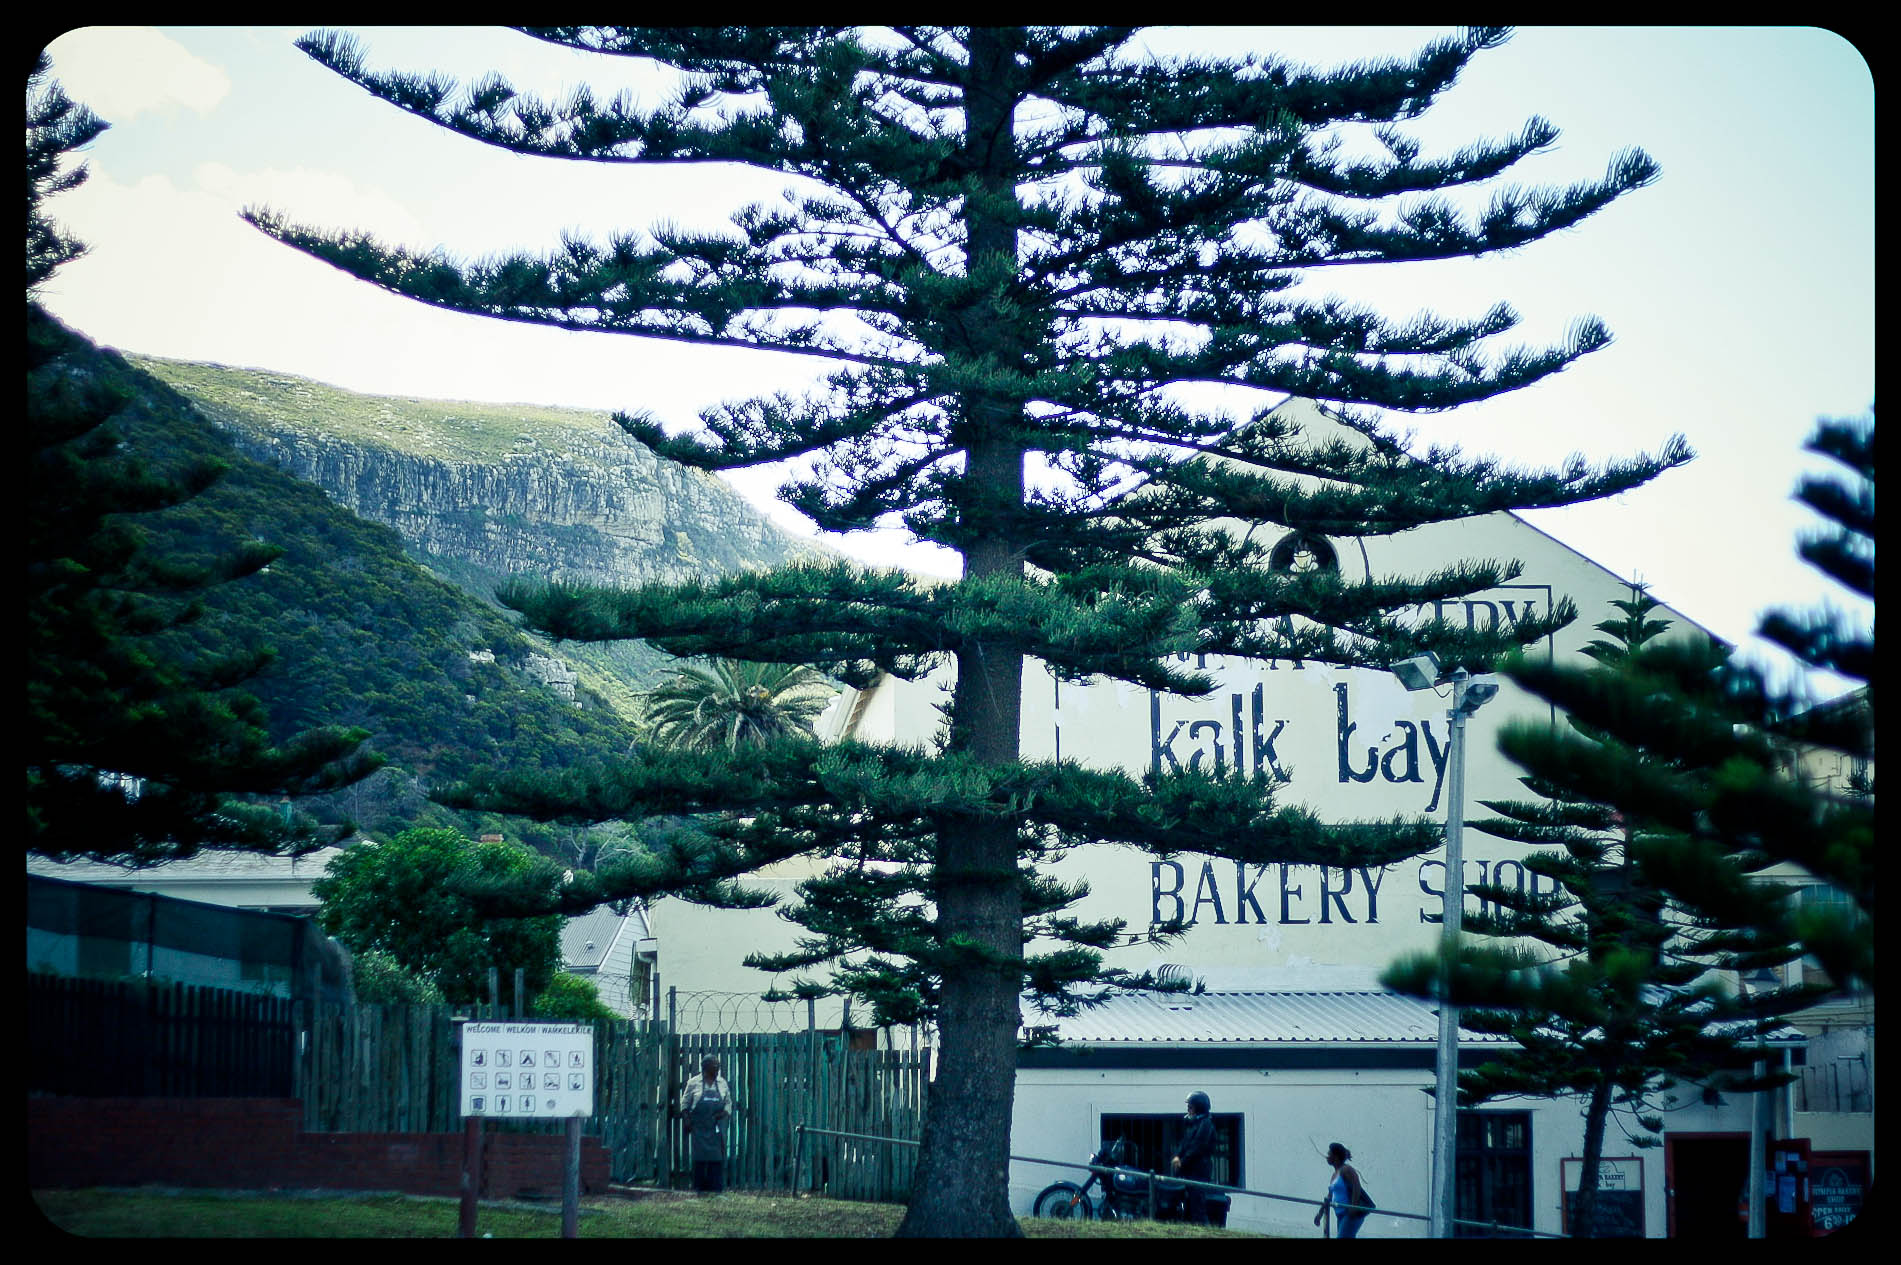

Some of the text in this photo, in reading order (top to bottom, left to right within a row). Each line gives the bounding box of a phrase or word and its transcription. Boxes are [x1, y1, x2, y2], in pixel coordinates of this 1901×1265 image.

[1150, 682, 1452, 813] kalk bay
[1149, 860, 1385, 925] BAKERY
[465, 1025, 501, 1034] WELCOME
[506, 1026, 537, 1034] WELKOM
